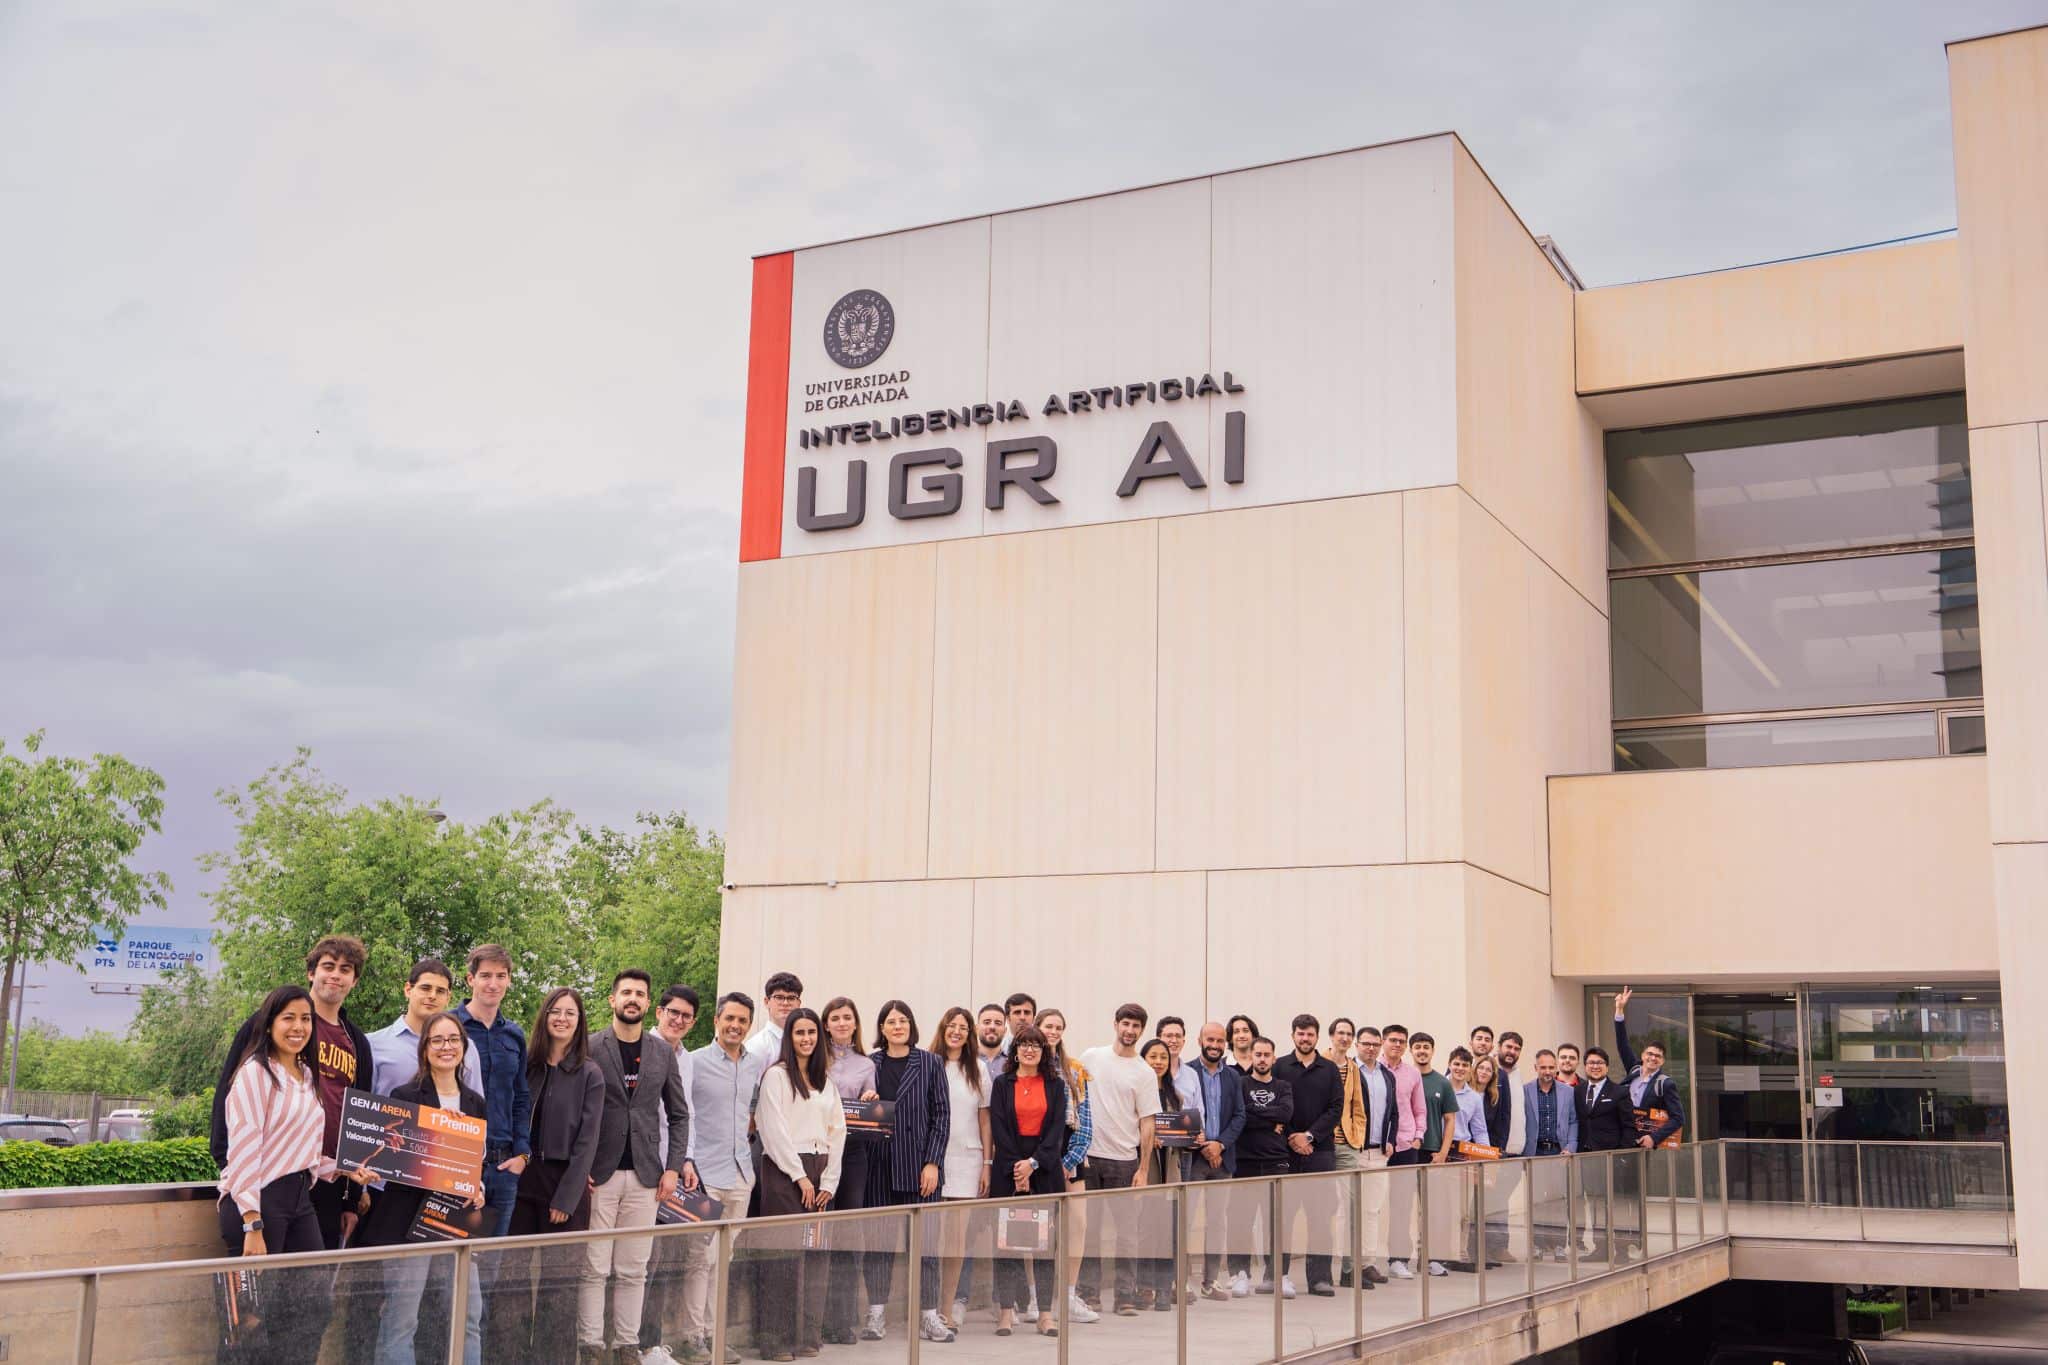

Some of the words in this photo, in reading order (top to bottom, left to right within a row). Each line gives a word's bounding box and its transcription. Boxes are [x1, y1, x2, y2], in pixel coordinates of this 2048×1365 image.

[805, 370, 910, 396] UNIVERSIDAD
[804, 399, 824, 413] DE
[827, 387, 909, 410] GRANADA
[799, 399, 1029, 450] INTELIGENCIA
[1042, 371, 1245, 416] ARTIFICIAL
[796, 435, 1061, 532] UGR
[1116, 410, 1246, 498] AI
[128, 941, 172, 951] PARQUE
[95, 958, 115, 967] PTS
[127, 960, 141, 968] DE
[350, 1096, 369, 1109] GEN
[371, 1103, 380, 1112] AI
[381, 1104, 412, 1119] ARENA
[347, 1117, 378, 1132] Otorgado
[440, 1114, 480, 1135] Premio
[345, 1130, 375, 1144] Valorado
[375, 1138, 385, 1146] en
[454, 1181, 475, 1193] sidn
